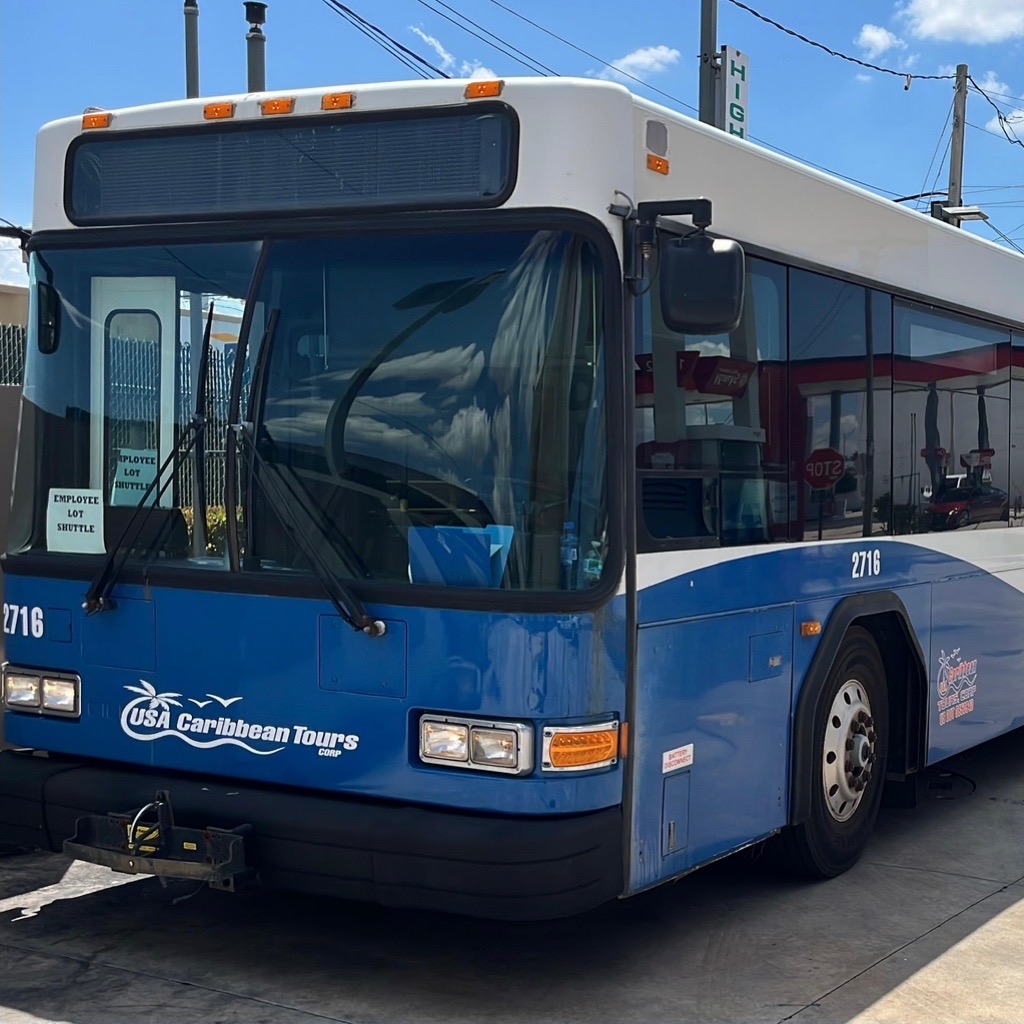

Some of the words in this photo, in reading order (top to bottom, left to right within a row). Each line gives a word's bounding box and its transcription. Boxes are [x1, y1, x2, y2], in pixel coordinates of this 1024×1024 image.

[730, 59, 746, 139] HIGH
[119, 455, 156, 465] PLOYEE
[124, 468, 140, 477] LOT
[54, 494, 99, 505] EMPLOYEE
[67, 510, 84, 518] LOT
[57, 523, 95, 533] SHUTTLE
[852, 549, 881, 578] 2716
[3, 603, 44, 638] 2716
[129, 707, 170, 729] USA
[176, 712, 291, 743] Caribbean
[293, 725, 360, 750] Tours
[317, 748, 342, 758] CORP
